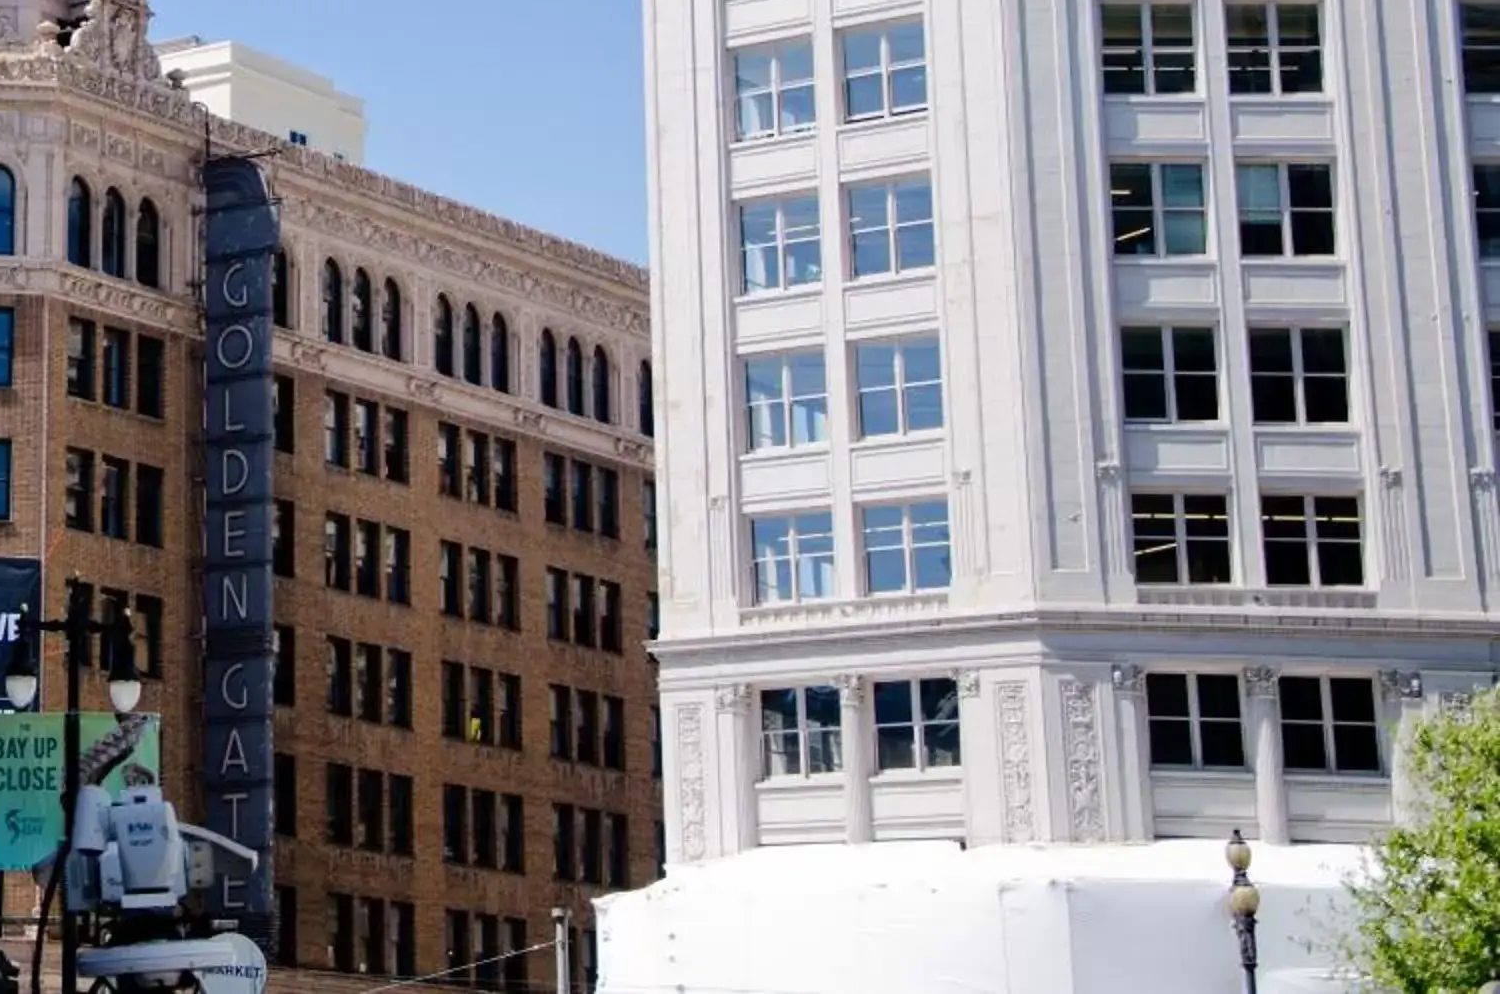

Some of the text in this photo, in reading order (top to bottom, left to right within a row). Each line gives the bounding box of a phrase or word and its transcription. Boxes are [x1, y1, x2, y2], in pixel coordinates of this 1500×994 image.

[34, 737, 58, 759] UP
[216, 262, 253, 907] GOLDEN GATE
